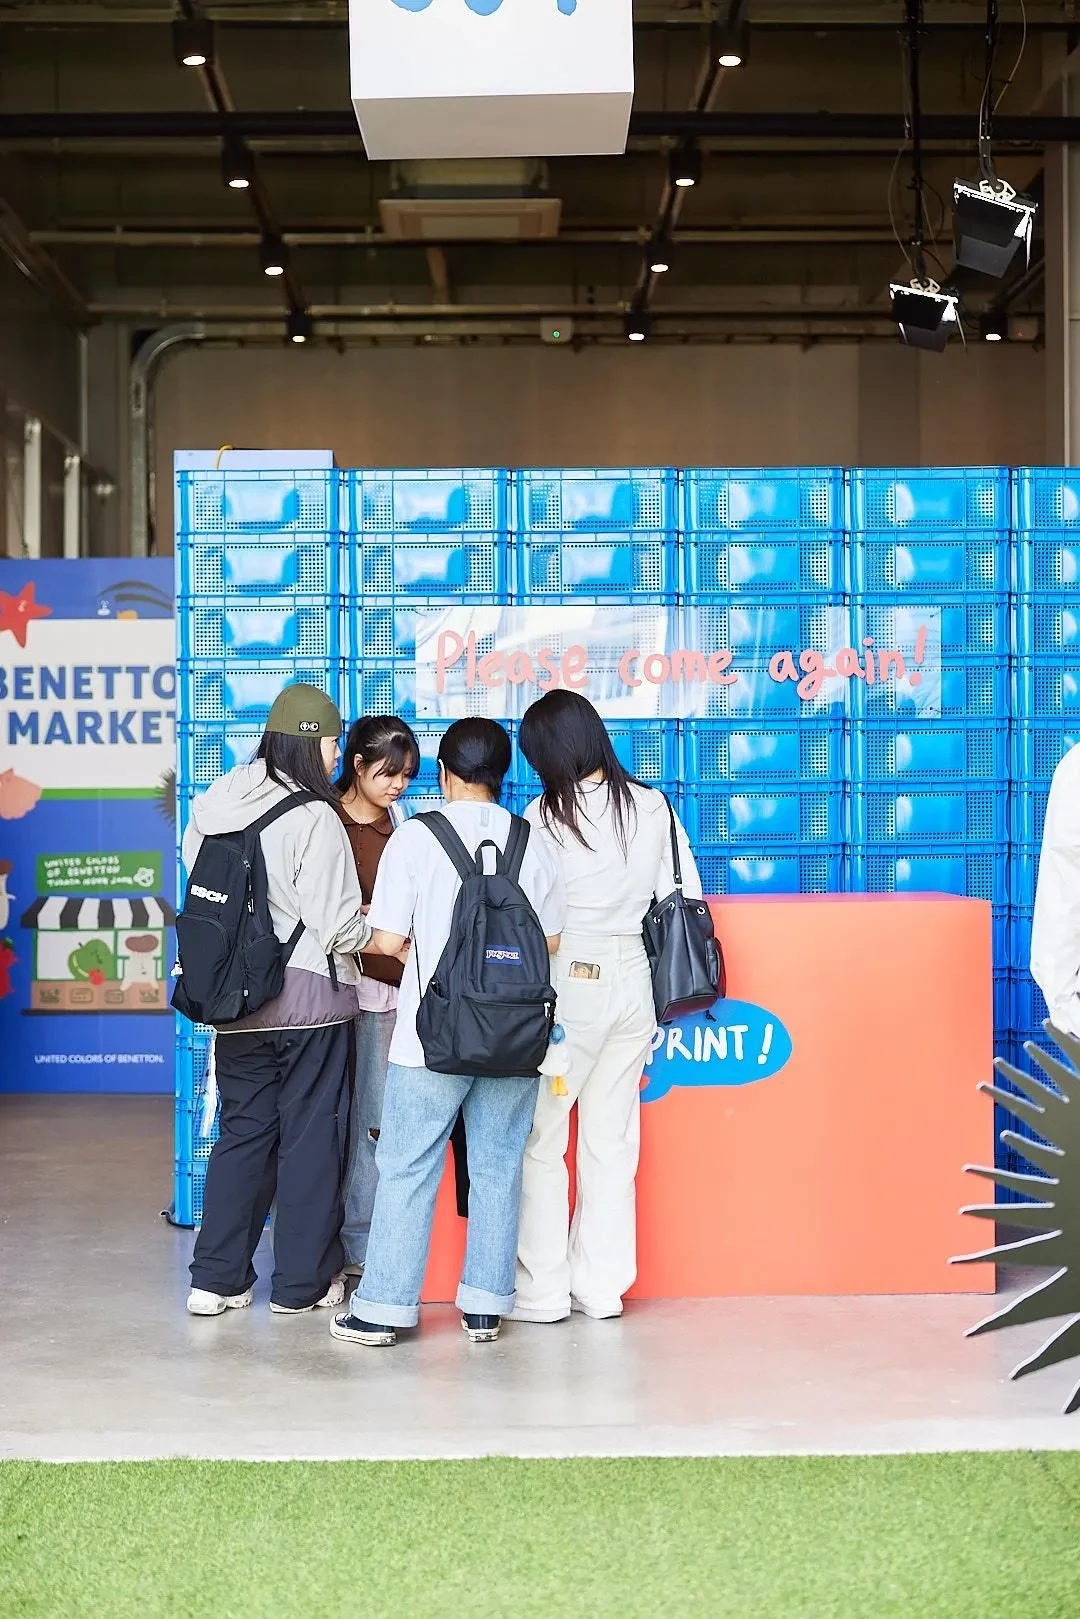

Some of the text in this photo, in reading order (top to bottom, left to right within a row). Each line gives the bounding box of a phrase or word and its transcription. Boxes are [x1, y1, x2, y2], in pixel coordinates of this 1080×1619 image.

[435, 625, 927, 701] Please come again!
